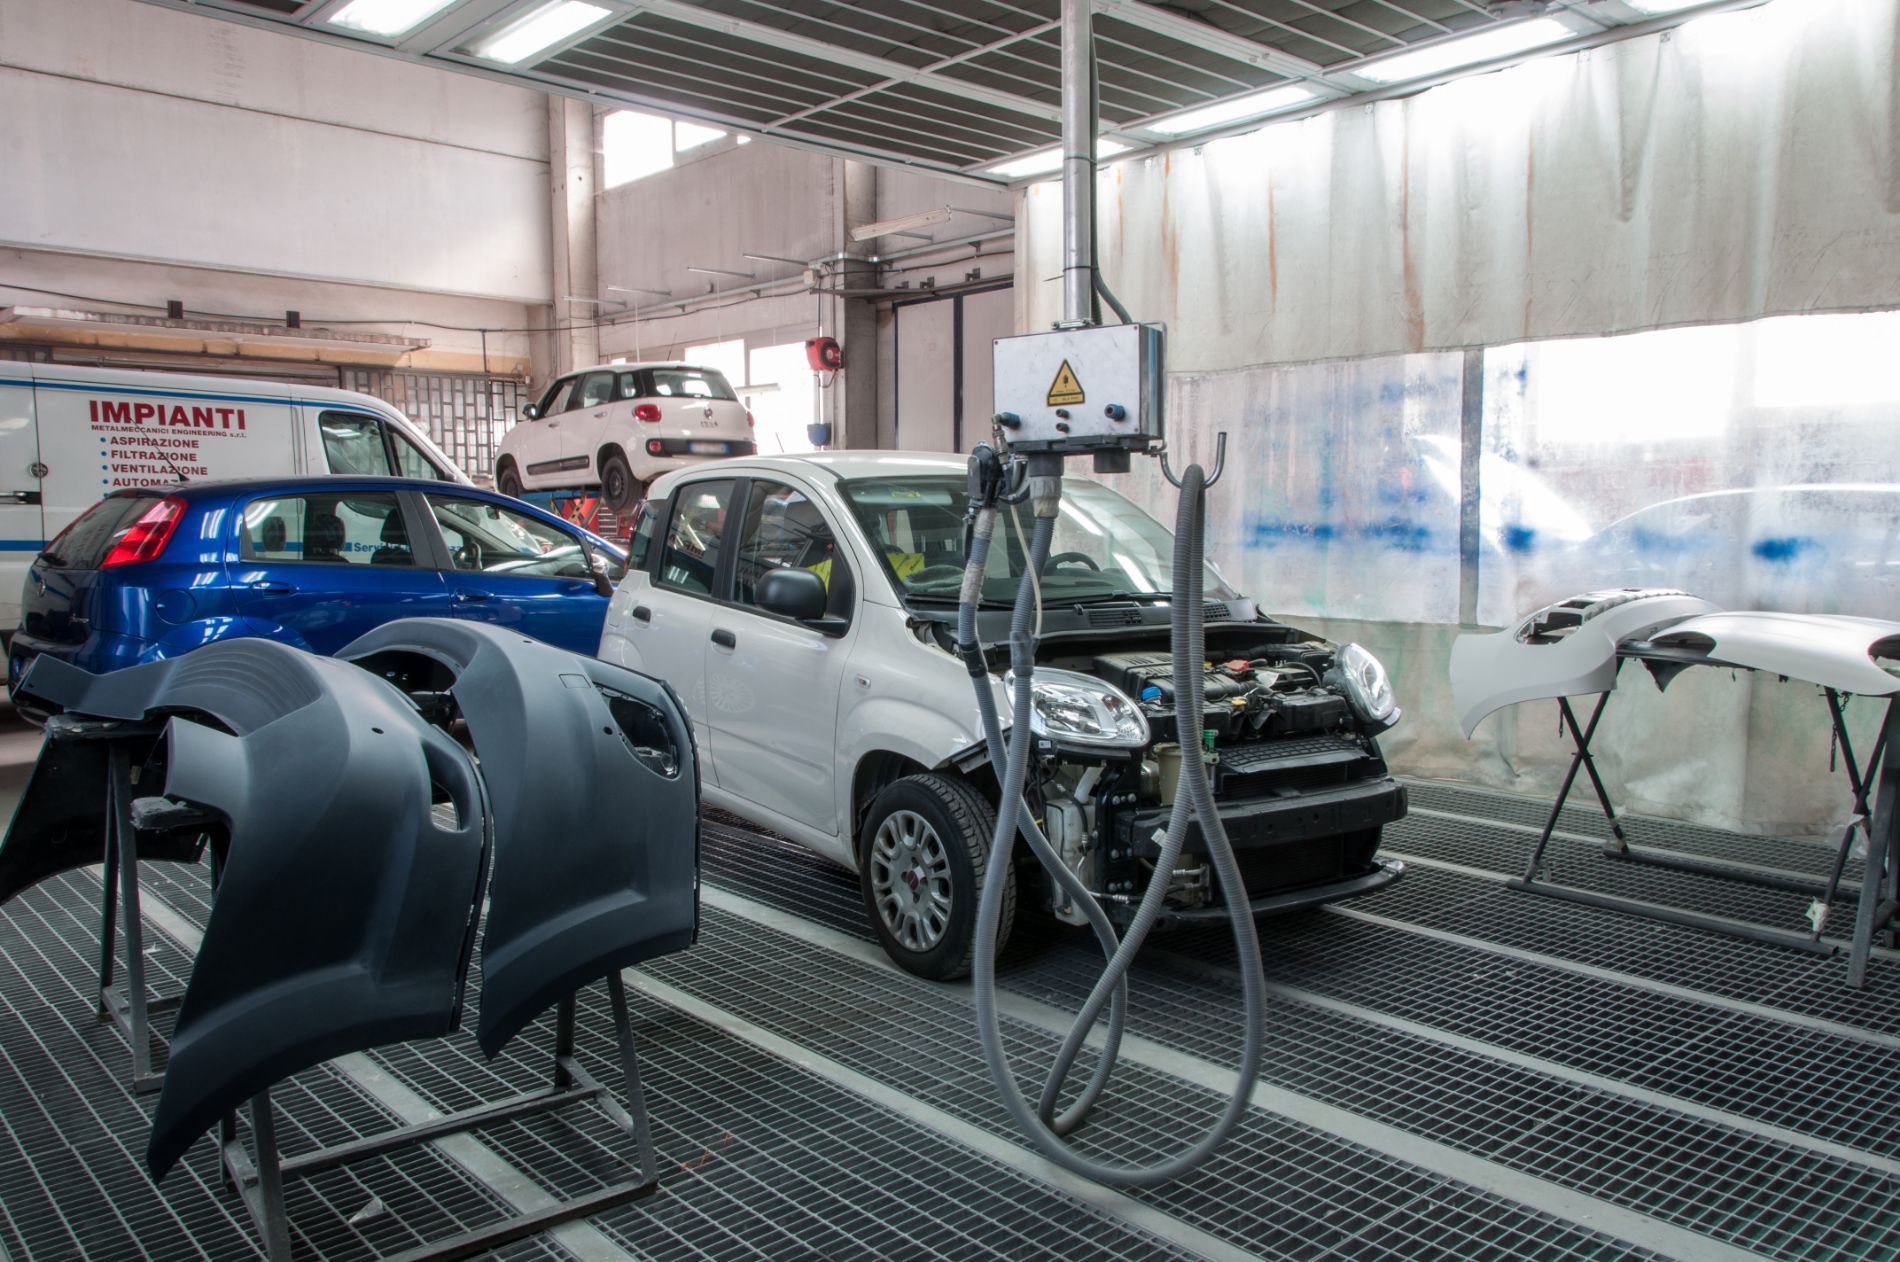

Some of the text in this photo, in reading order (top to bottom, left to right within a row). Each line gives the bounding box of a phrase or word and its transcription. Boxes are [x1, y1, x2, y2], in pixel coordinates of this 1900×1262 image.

[89, 400, 246, 430] IMPIANTI
[91, 424, 169, 434] METALMECCANICI
[171, 428, 227, 437] ENGINEERING
[110, 436, 199, 448] ASPIRAZIONE
[111, 450, 197, 461] FILTRAZIONE
[111, 464, 208, 475] VENTILAZIONE
[112, 478, 178, 487] AUTOMA
